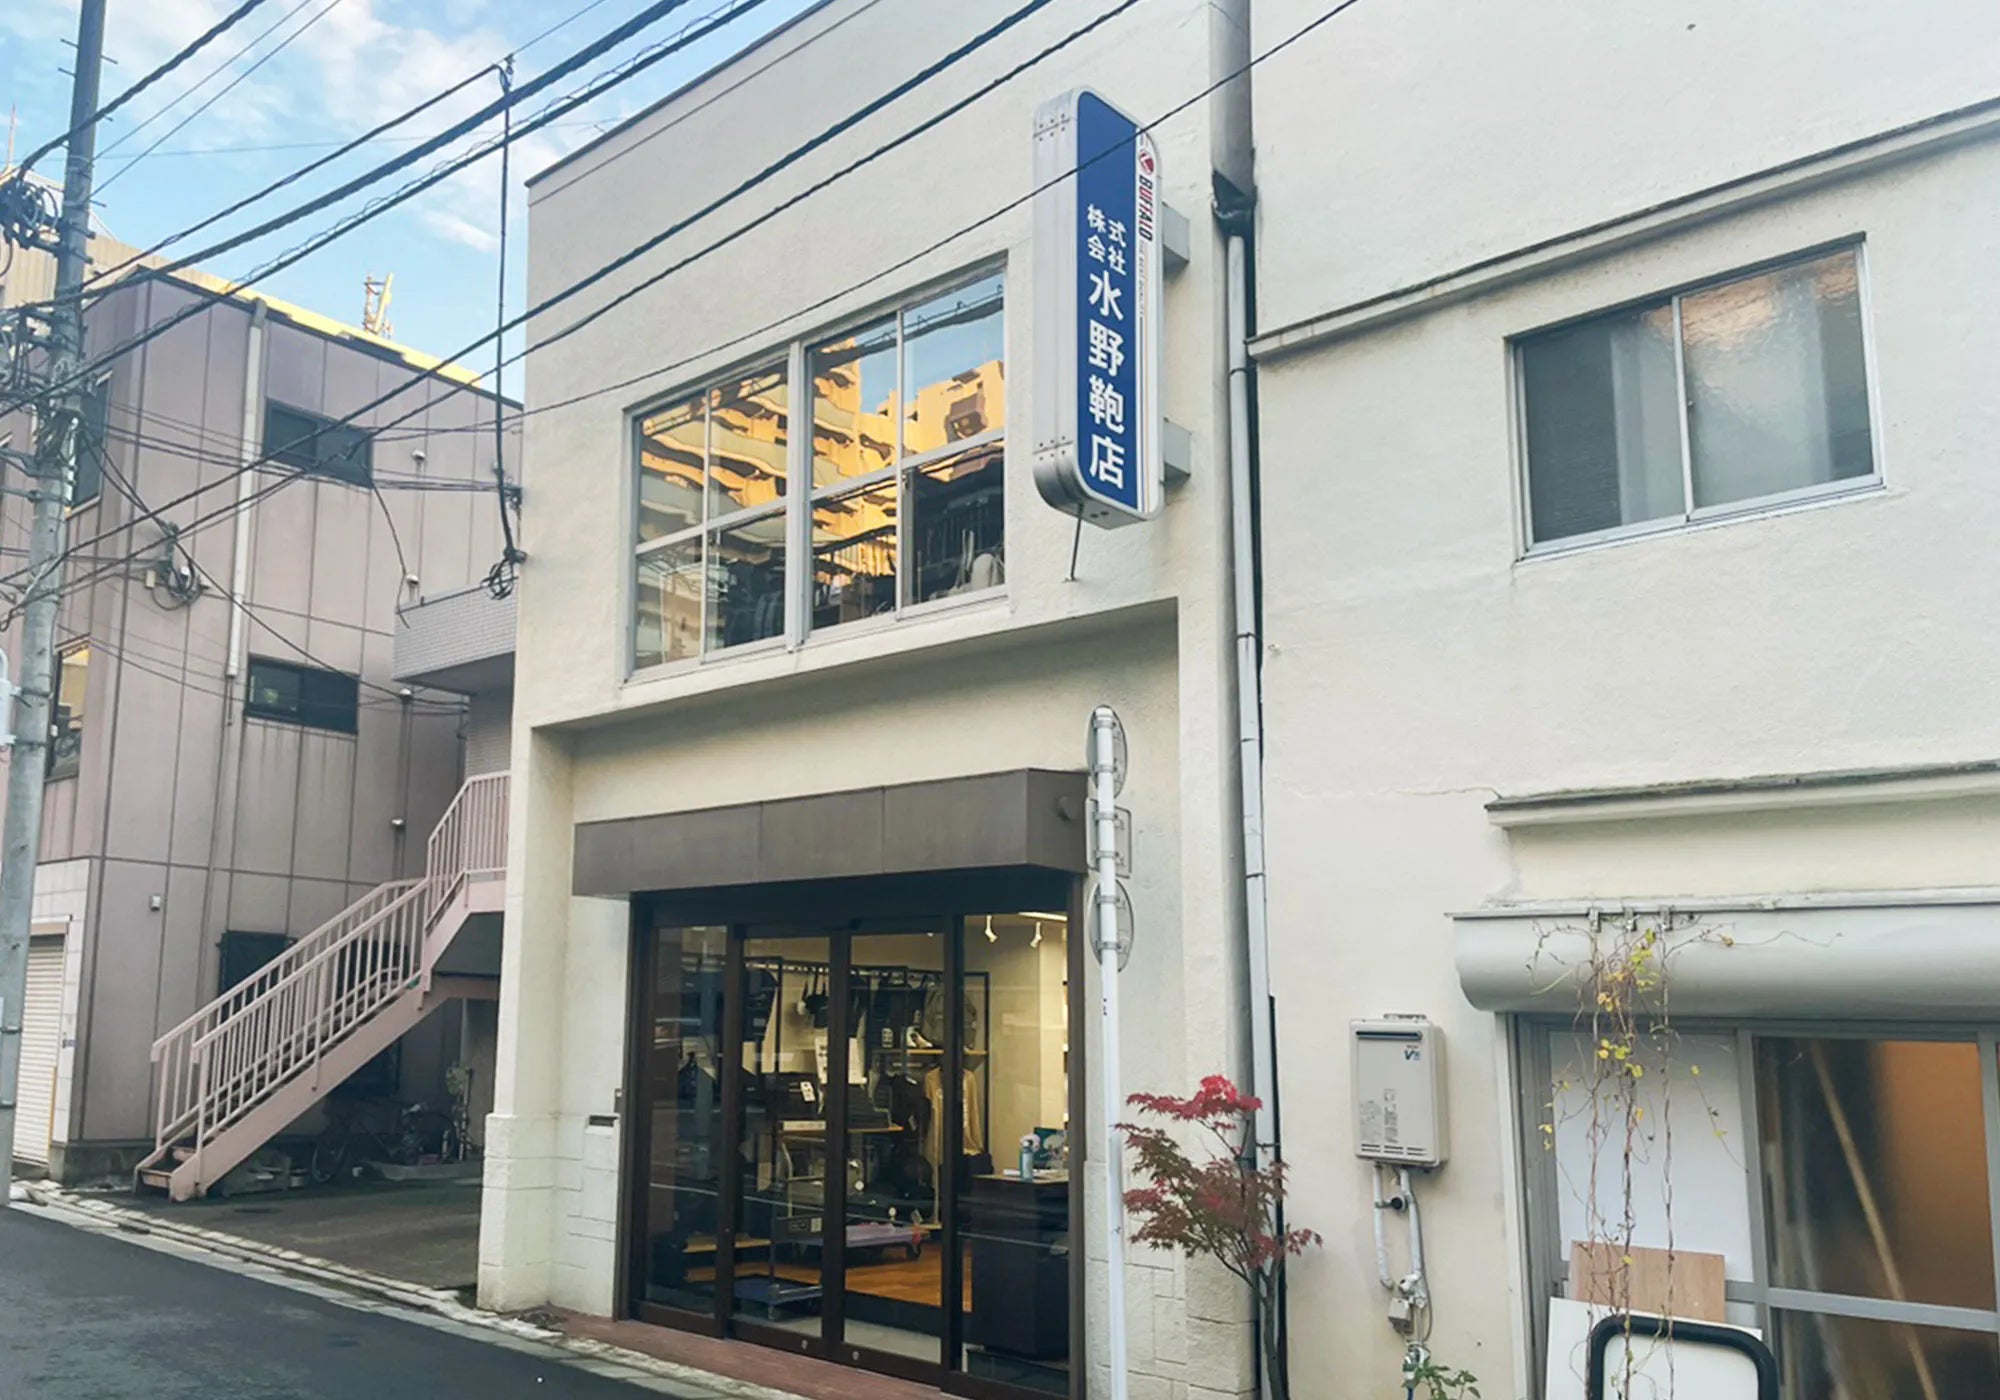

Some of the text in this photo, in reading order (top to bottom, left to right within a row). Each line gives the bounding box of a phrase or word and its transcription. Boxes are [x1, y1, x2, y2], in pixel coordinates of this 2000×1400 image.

[1138, 174, 1154, 242] BUFFALO
[1088, 269, 1125, 490] 水野鞄店
